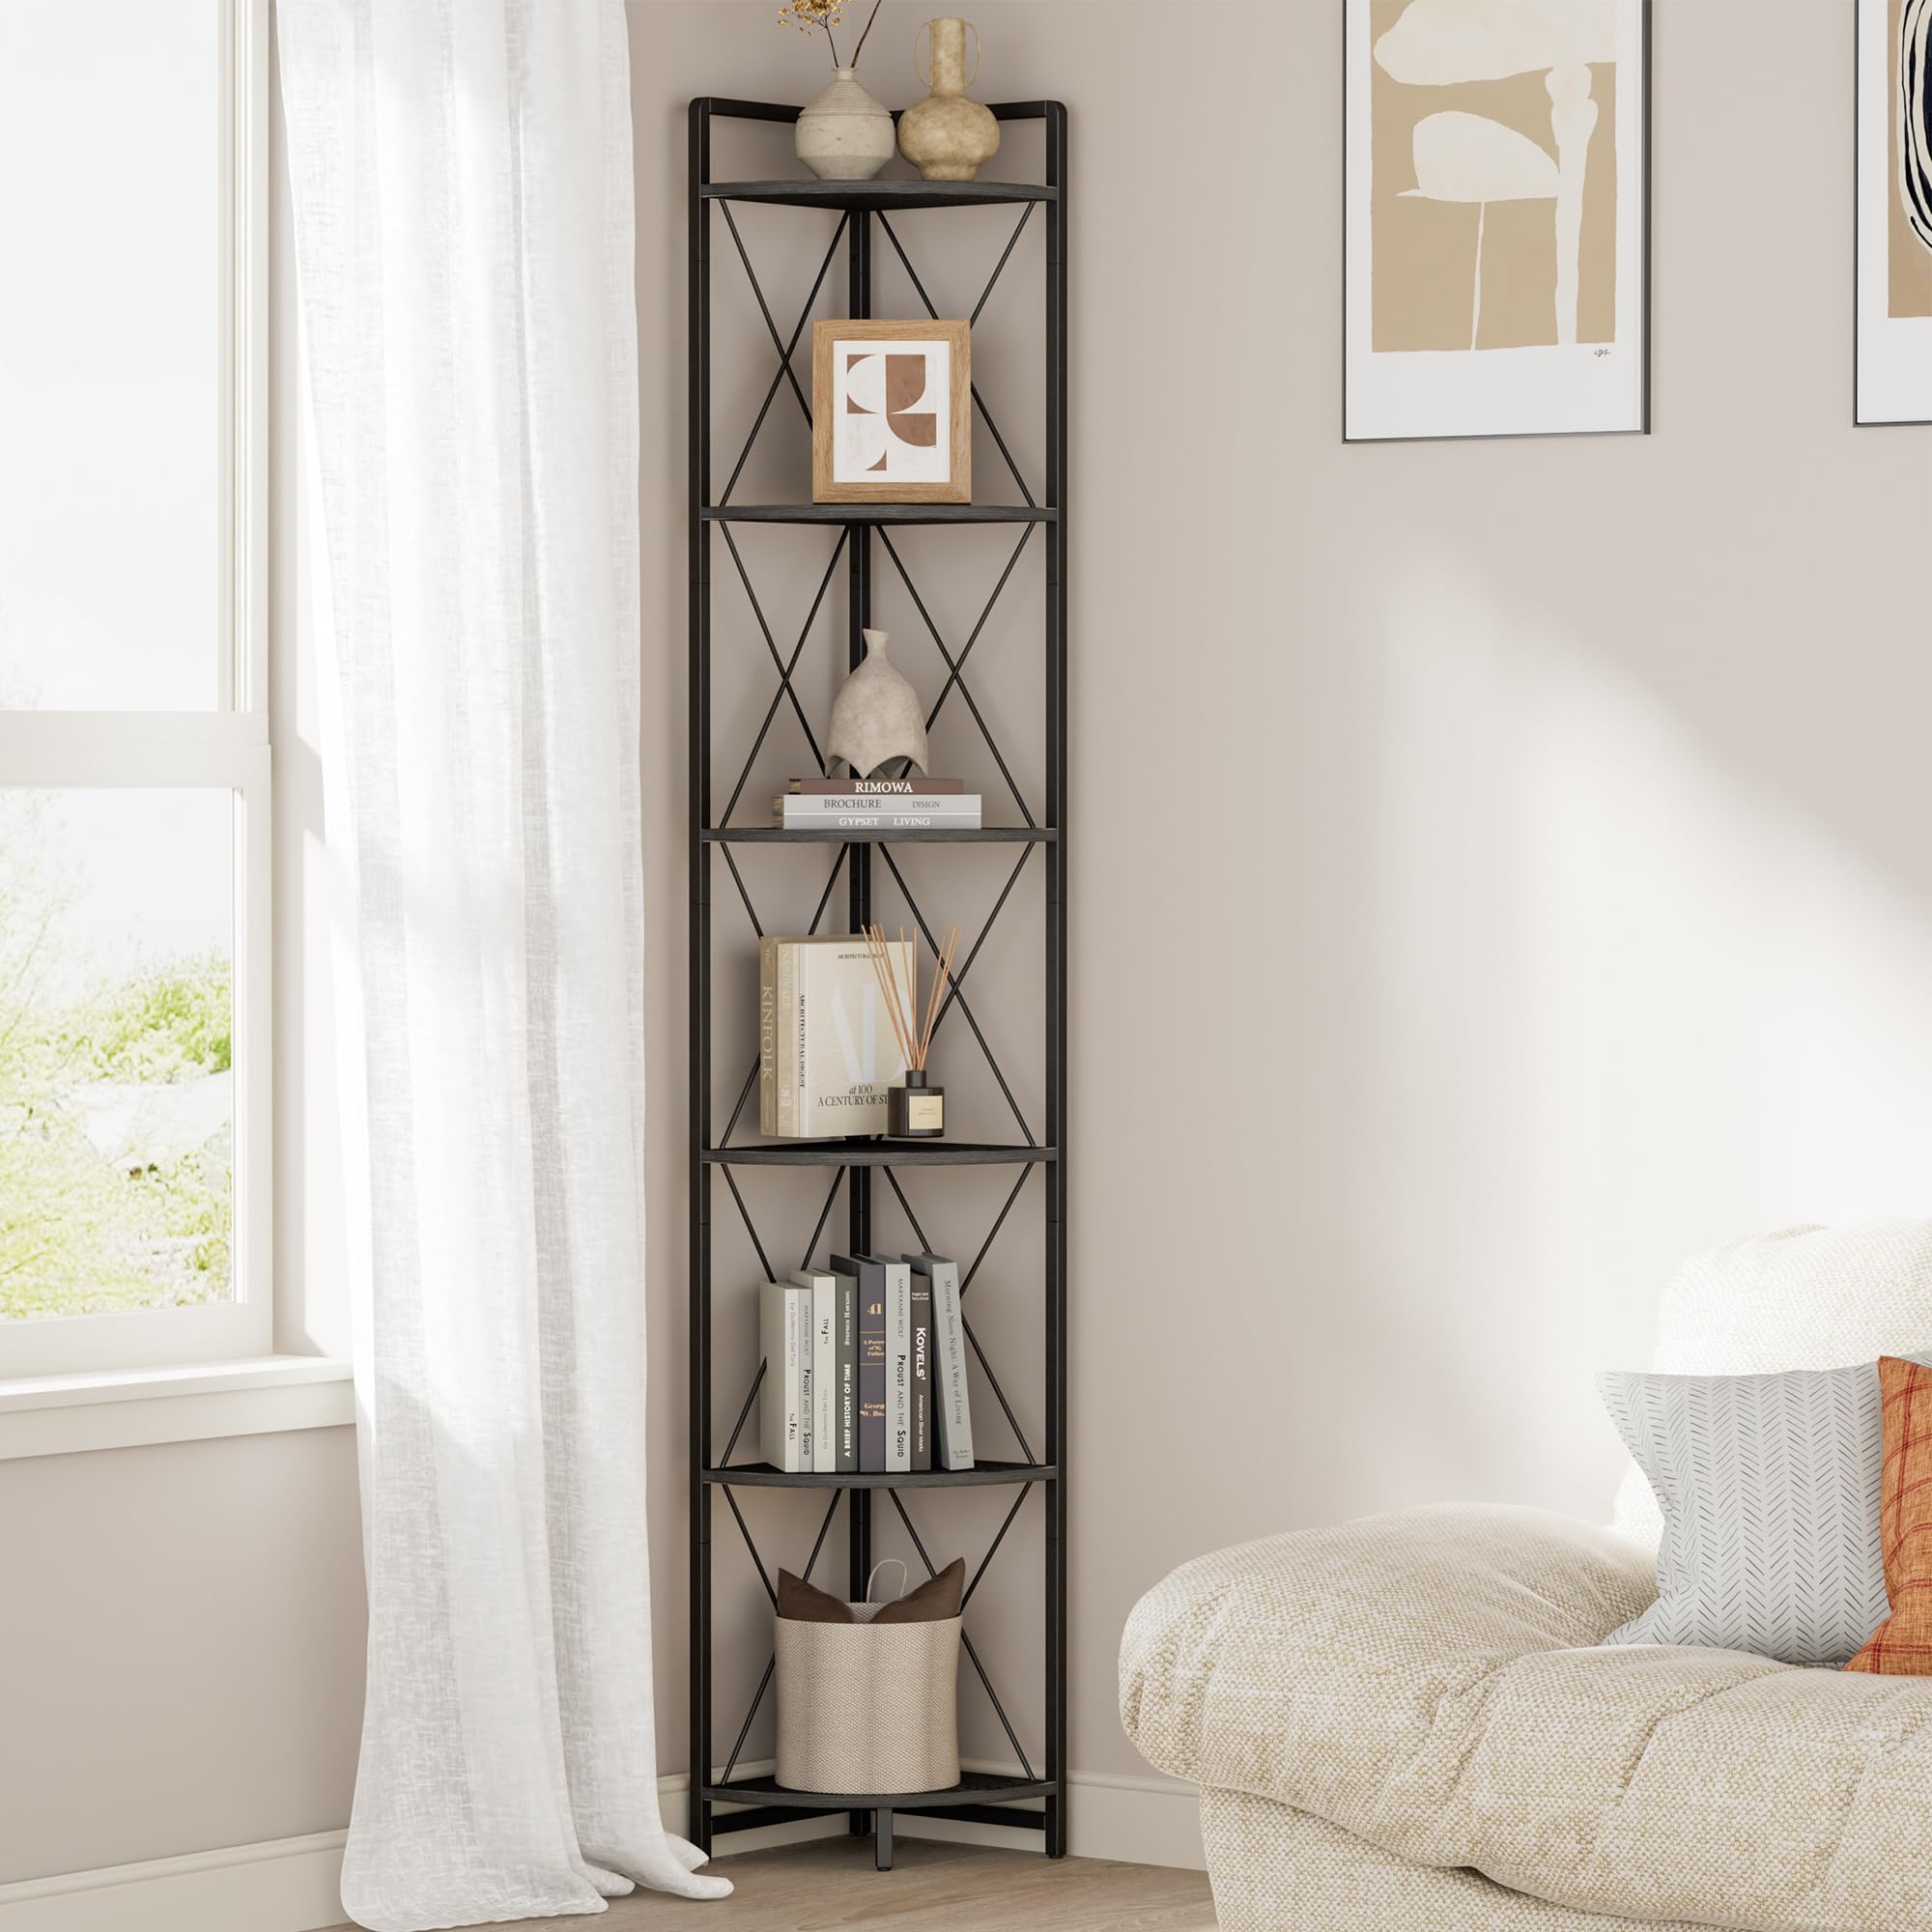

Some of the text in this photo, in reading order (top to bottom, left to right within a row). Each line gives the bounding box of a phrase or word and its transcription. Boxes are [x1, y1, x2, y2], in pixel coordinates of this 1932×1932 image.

[855, 781, 914, 793] RIMOWA
[824, 799, 882, 809] BROCHURE
[838, 817, 930, 826] GYPSET LIVING
[762, 986, 773, 1079] KINFOLK
[849, 1083, 872, 1094] at 100
[817, 1096, 824, 1107] A
[825, 1094, 866, 1107] CENTURY
[866, 1094, 877, 1105] OF
[944, 1280, 952, 1314] Morning
[952, 1372, 960, 1387] Way
[844, 1383, 850, 1394] OF
[954, 1399, 963, 1426] Living
